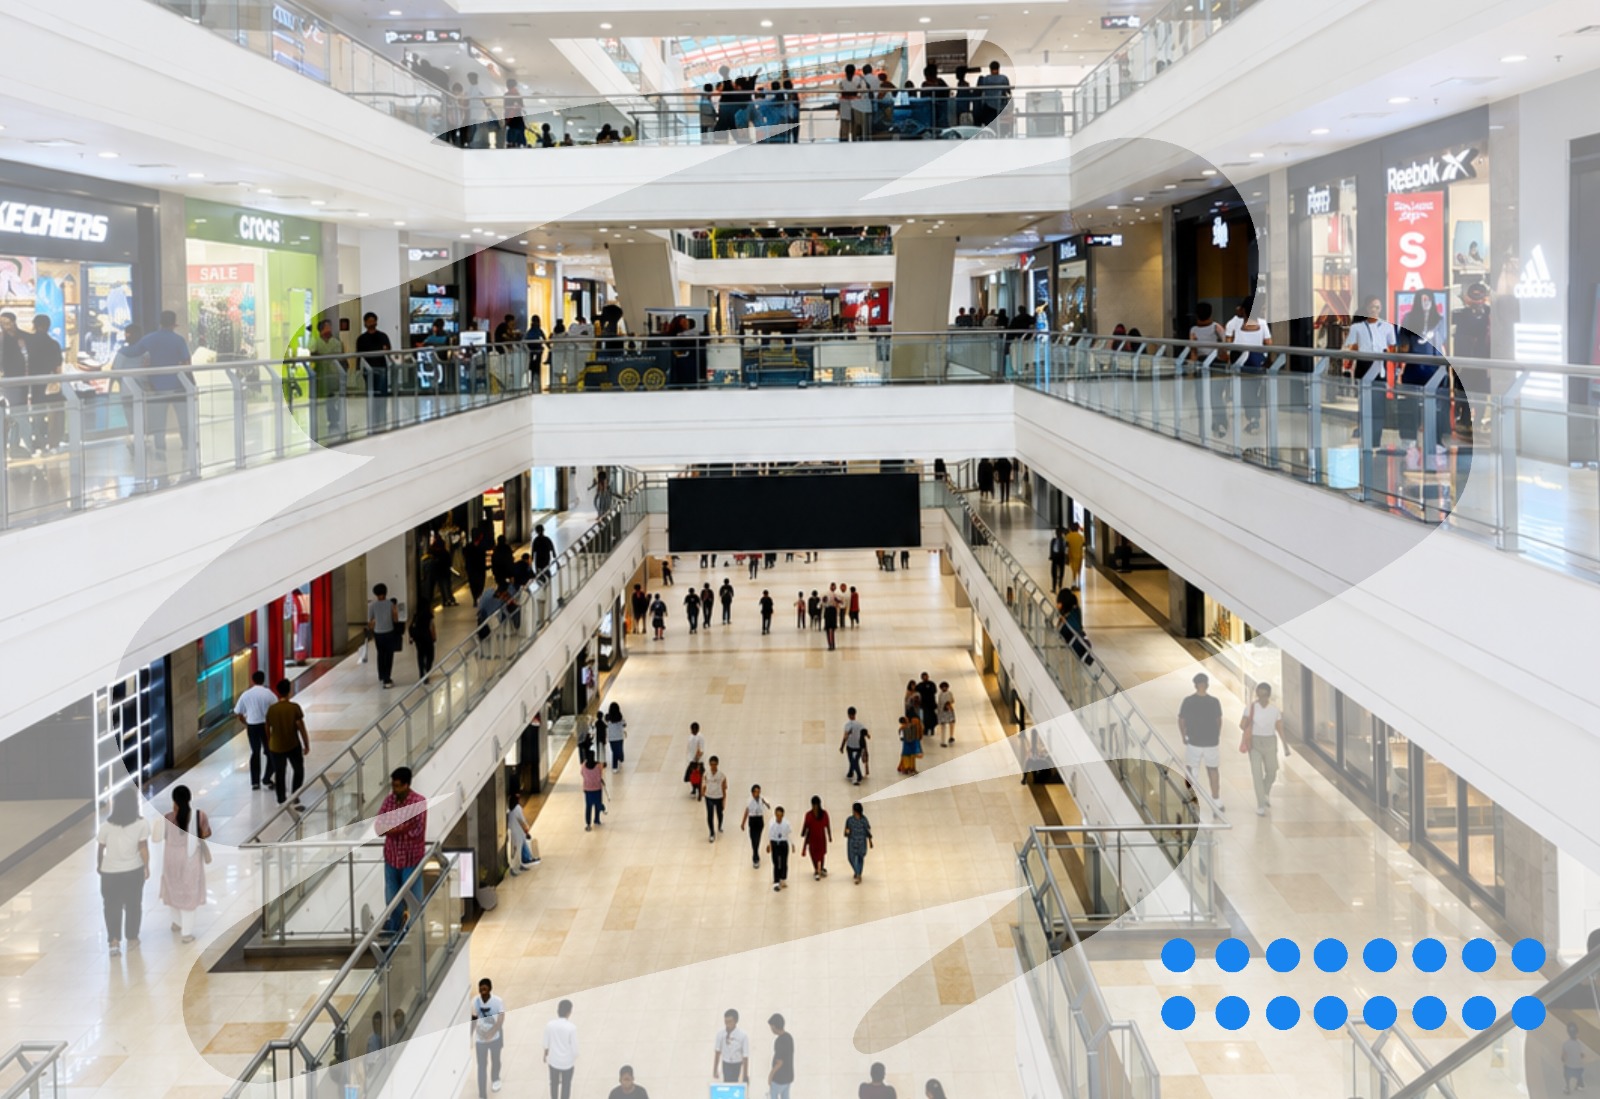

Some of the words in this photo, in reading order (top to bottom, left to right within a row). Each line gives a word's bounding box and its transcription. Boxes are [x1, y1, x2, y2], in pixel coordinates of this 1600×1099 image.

[1387, 157, 1440, 194] Reebok
[240, 215, 281, 243] crocs
[200, 266, 238, 281] SALE
